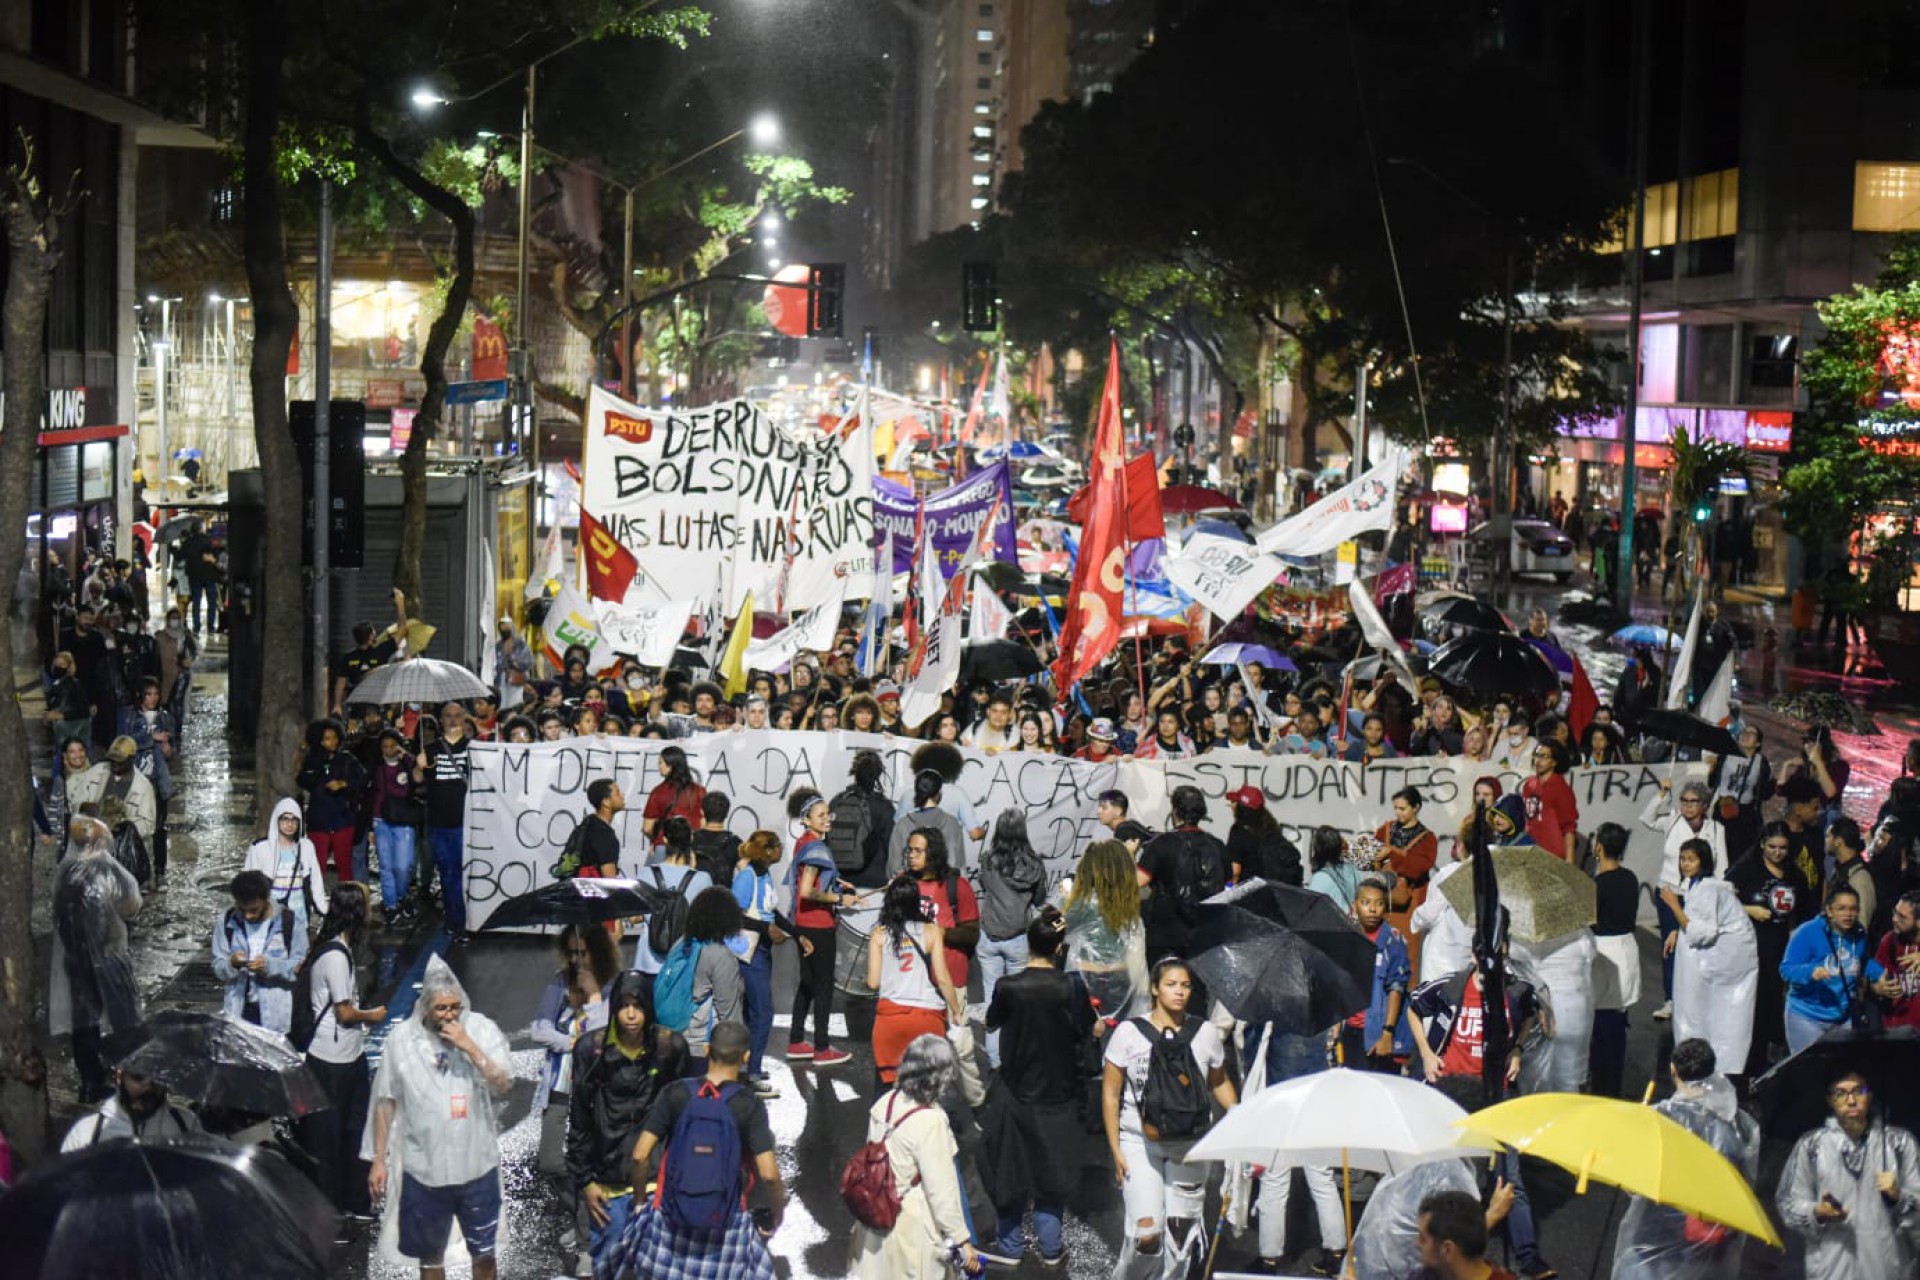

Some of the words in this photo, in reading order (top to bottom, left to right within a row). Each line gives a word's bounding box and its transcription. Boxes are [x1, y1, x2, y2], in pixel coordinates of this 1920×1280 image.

[49, 389, 86, 430] KING
[609, 418, 648, 437] PSTU
[614, 447, 854, 511] BOLSONARO
[658, 510, 735, 552] LUTAS
[466, 746, 531, 796] EM
[751, 746, 817, 801] DA
